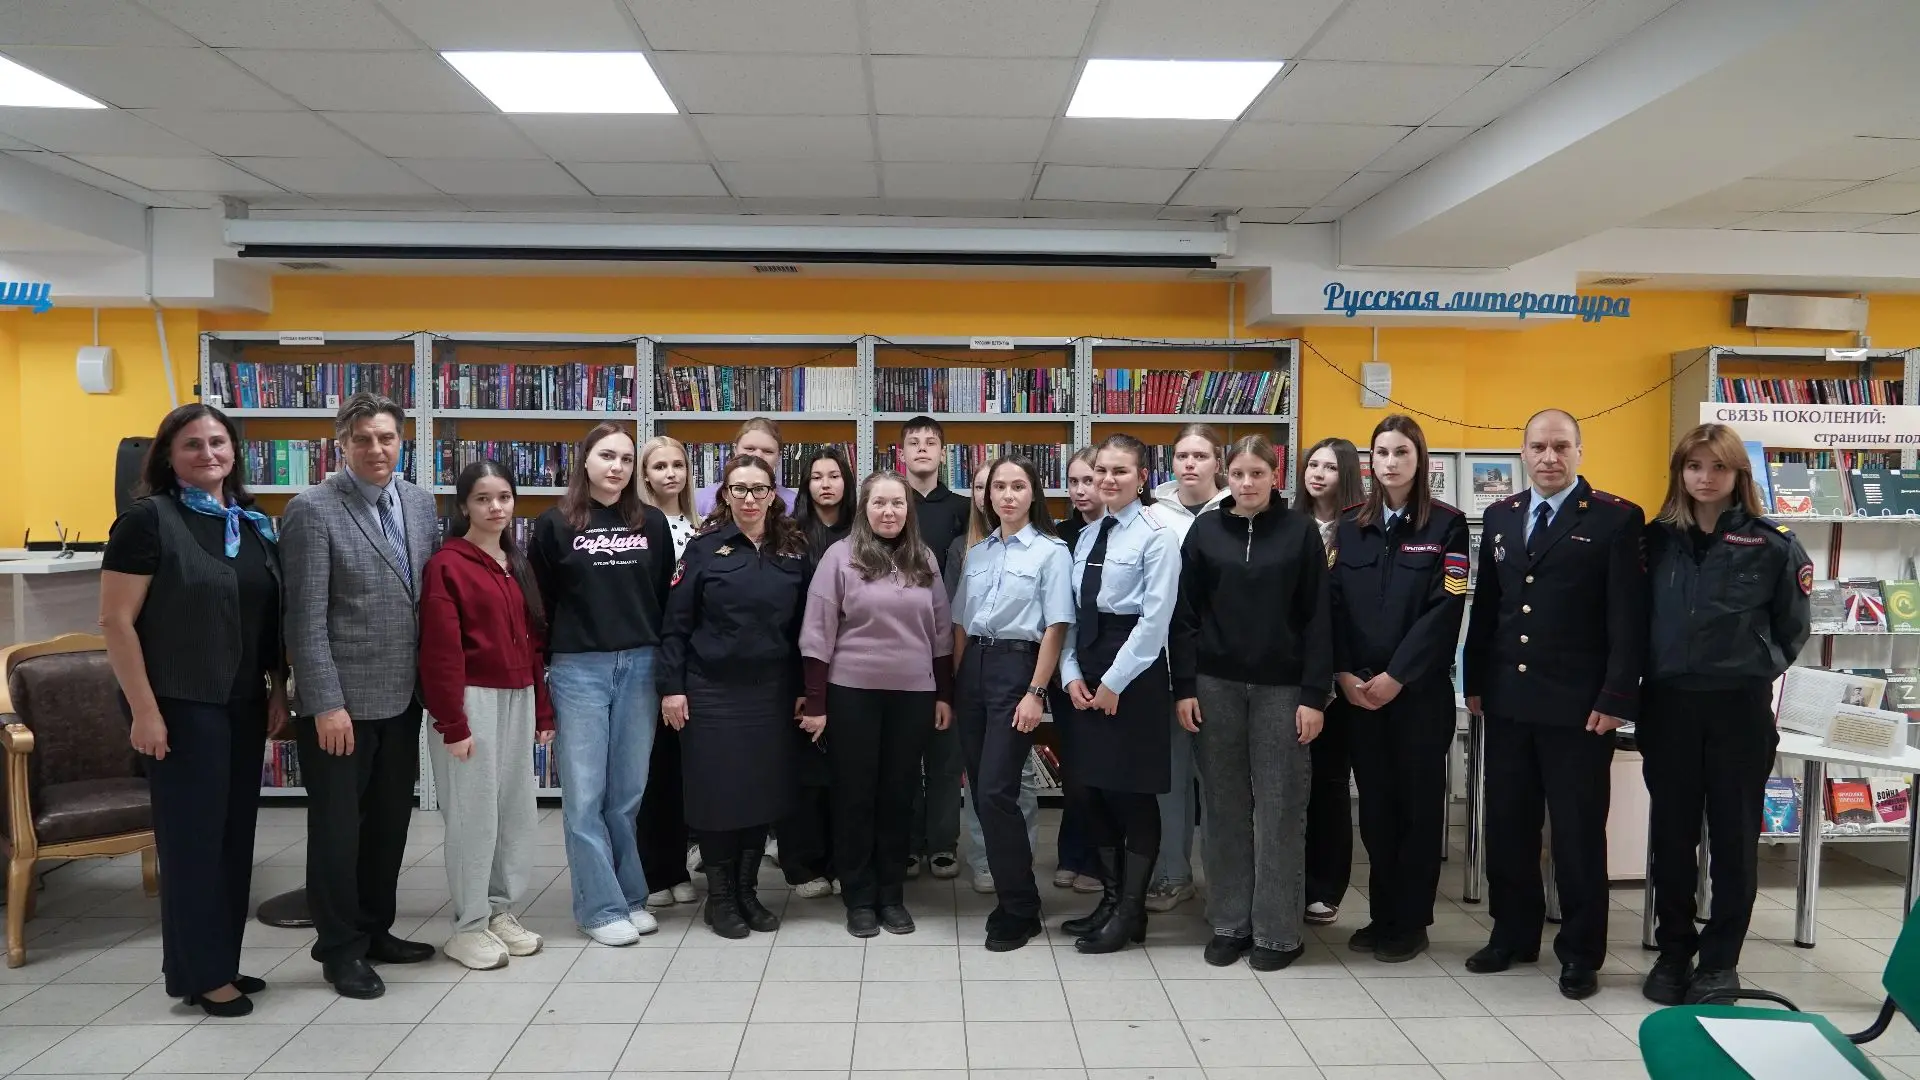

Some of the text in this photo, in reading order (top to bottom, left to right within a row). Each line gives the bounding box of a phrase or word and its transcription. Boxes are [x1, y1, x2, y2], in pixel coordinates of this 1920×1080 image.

[1323, 282, 1631, 323] Русская литература
[1716, 408, 1886, 424] СВЯЗЬ ПОКОЛЕНИЙ:
[1813, 432, 1891, 446] страницы
